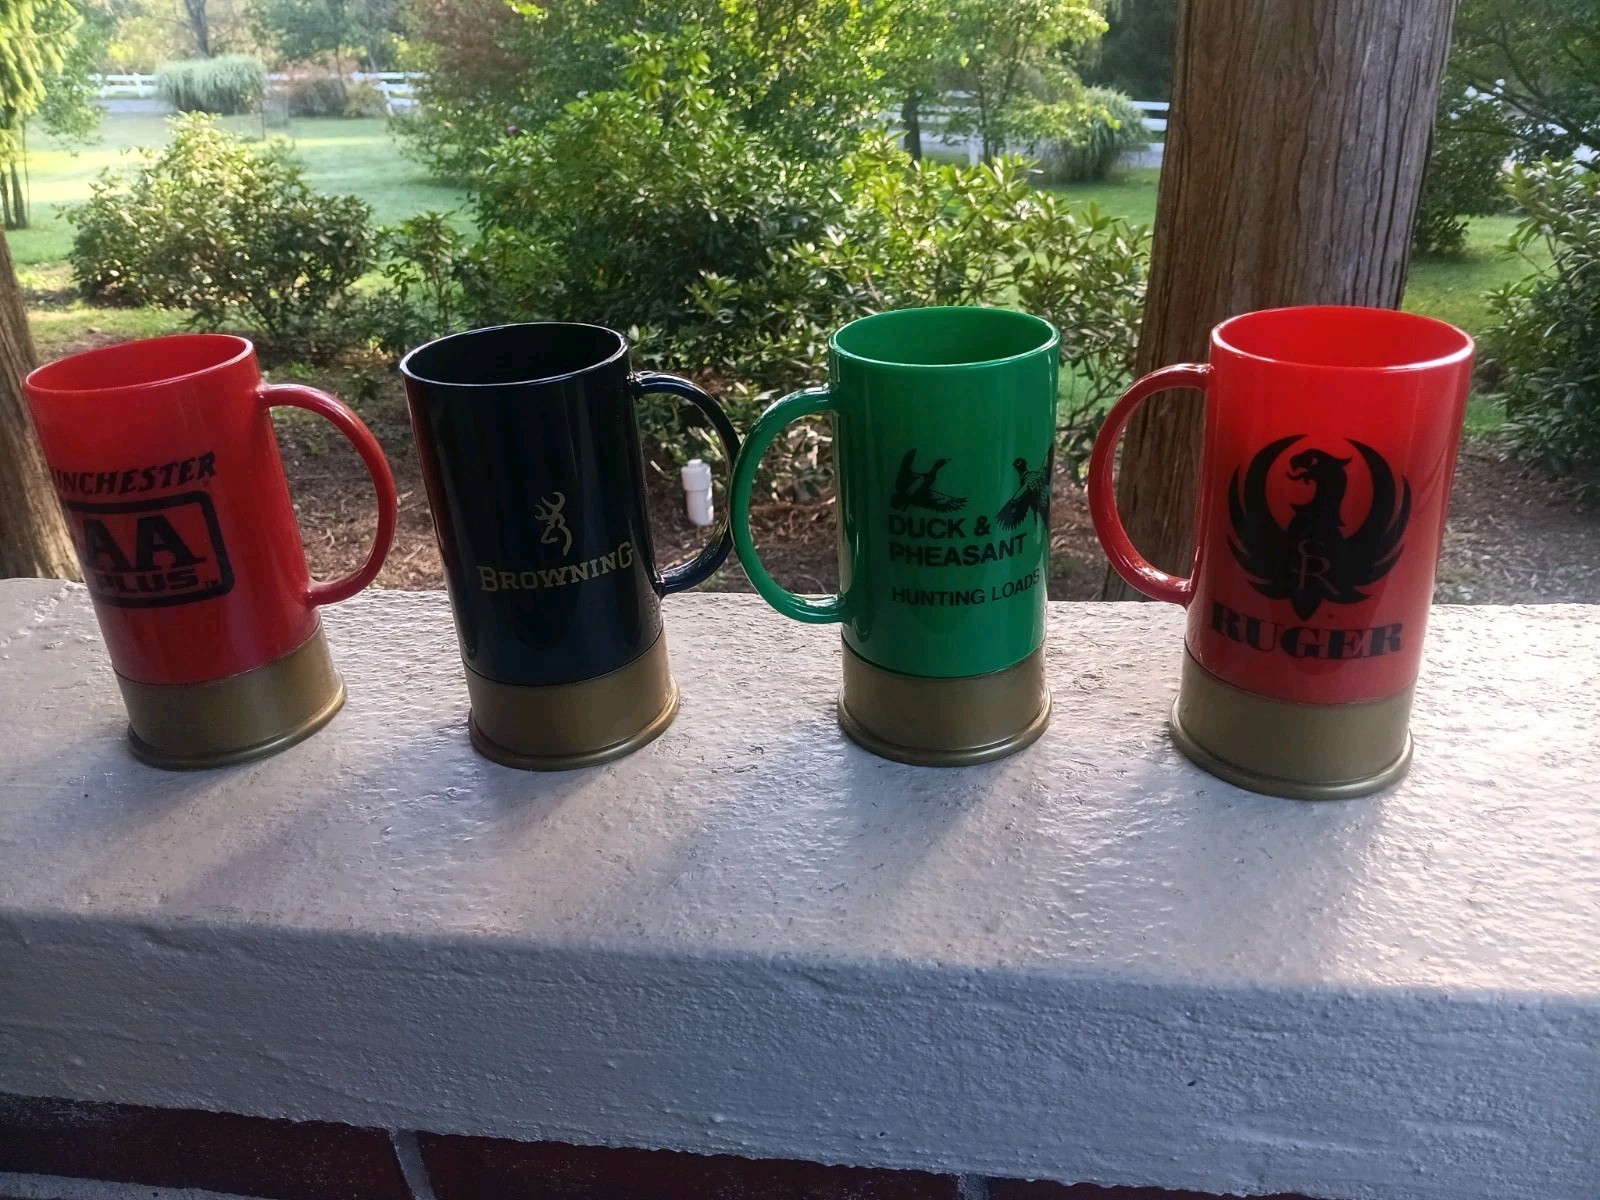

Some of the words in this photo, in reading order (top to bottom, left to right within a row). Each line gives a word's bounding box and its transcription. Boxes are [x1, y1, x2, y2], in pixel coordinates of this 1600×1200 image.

[83, 514, 207, 573] AA
[888, 514, 966, 539] DUCK
[974, 515, 991, 537] &
[476, 541, 634, 592] BROWNING
[888, 533, 1027, 567] PHEASANT
[892, 587, 985, 607] HUNTING
[991, 568, 1040, 602] LOADS
[1210, 601, 1403, 660] RUGER
